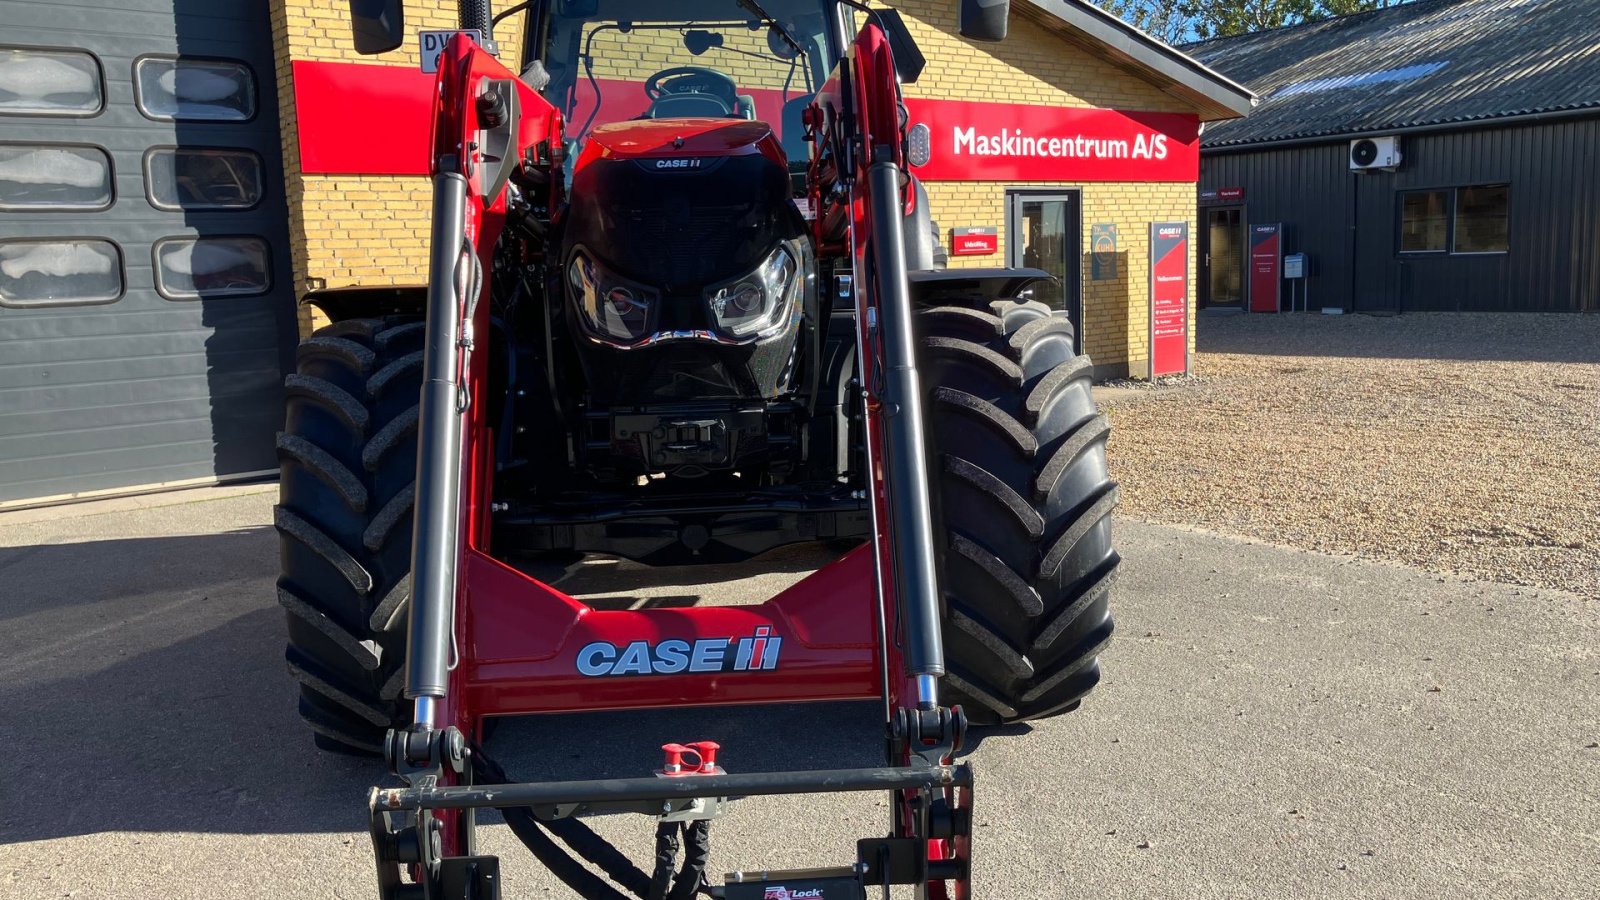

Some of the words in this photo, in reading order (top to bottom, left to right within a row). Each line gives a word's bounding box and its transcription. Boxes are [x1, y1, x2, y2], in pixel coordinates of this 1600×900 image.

[953, 126, 1128, 159] Maskincentrum
[1132, 133, 1168, 160] A/S
[656, 159, 688, 168] CASE
[1159, 227, 1175, 235] CASE
[576, 639, 728, 676] CASE
